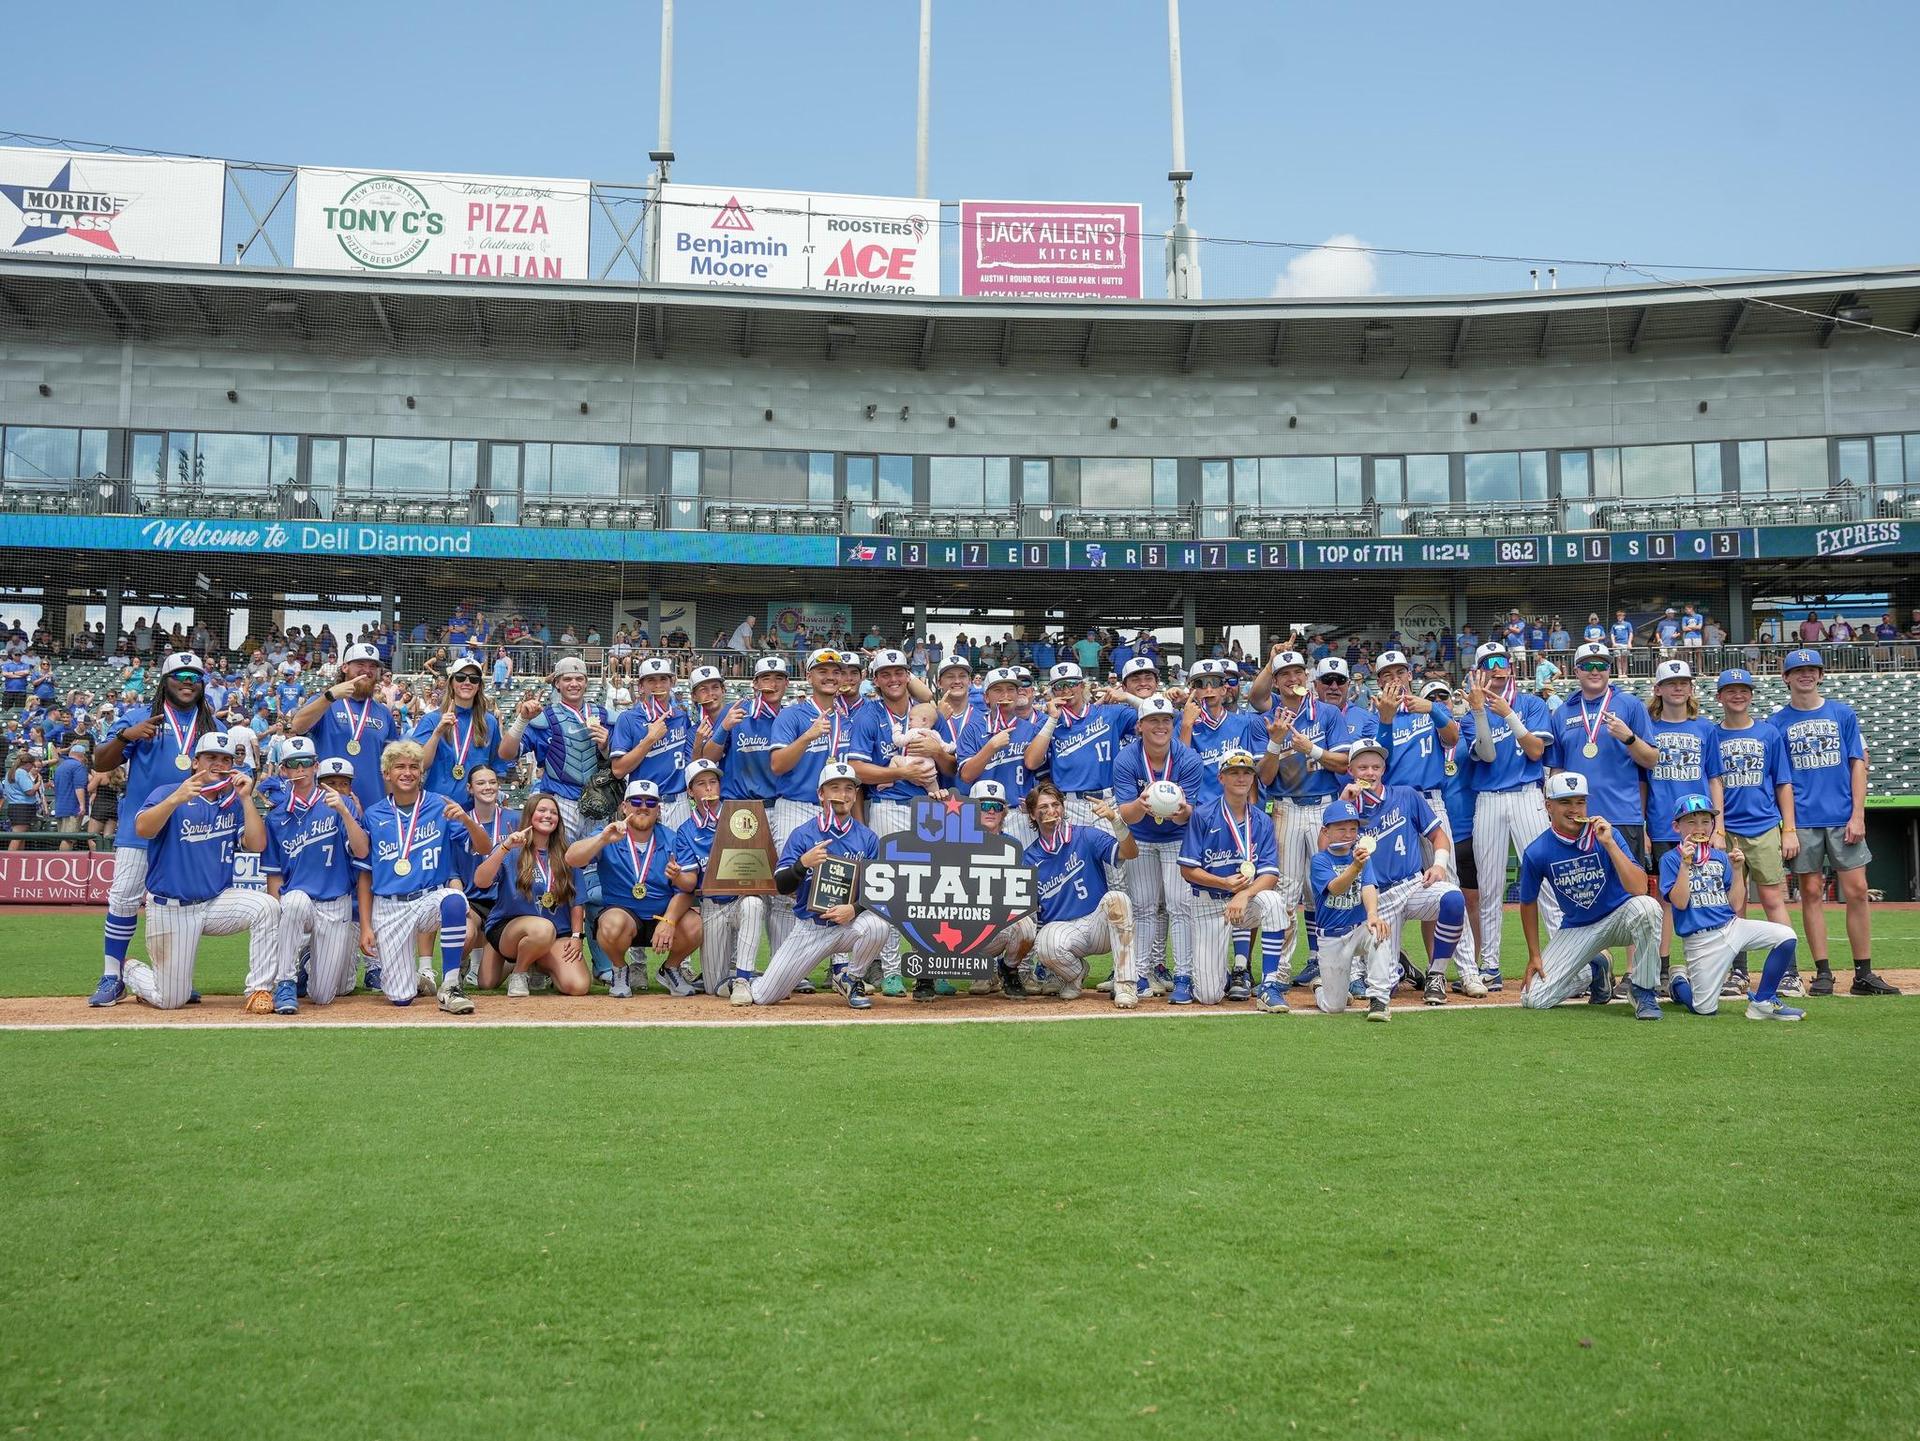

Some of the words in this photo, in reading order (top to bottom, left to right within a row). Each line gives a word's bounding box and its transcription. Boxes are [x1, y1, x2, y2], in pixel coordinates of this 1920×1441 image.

[28, 192, 111, 212] MORRIS
[350, 187, 368, 204] NEW
[370, 182, 395, 191] YORK
[396, 186, 420, 207] STYLE
[22, 211, 112, 231] GLASS
[323, 207, 397, 232] TONY
[402, 210, 443, 234] C'S
[468, 202, 548, 234] PIZZA
[827, 219, 913, 236] ROOSTERS
[986, 222, 1036, 243] JACK
[1038, 223, 1116, 245] ALLEN'S
[370, 255, 392, 264] BEER
[394, 239, 422, 262] GARDEN
[479, 238, 534, 251] Authentic
[676, 232, 788, 259] Benjamin
[802, 245, 816, 254] AT
[823, 238, 917, 280] ACE
[1039, 249, 1114, 261] KITCHEN
[690, 256, 768, 278] Moore
[824, 279, 916, 295] Hardware
[980, 274, 1004, 283] AUSTIN
[1009, 275, 1032, 284] ROUND
[1033, 275, 1050, 284] ROCK
[1056, 275, 1077, 285] CEDAR
[1078, 276, 1096, 285] PARK
[1101, 276, 1123, 286] HUTTO
[142, 520, 260, 549] Welcome
[264, 523, 290, 548] to
[302, 527, 349, 550] Dell
[358, 528, 472, 552] Diamond
[1816, 522, 1901, 556] EXPRESS
[886, 546, 896, 561] R
[910, 545, 919, 562] 3
[945, 547, 956, 562] H
[970, 546, 980, 563] 7
[1008, 547, 1018, 562] E
[1030, 546, 1040, 563] 0
[1126, 549, 1136, 564] R
[1149, 547, 1158, 564] 5
[1184, 549, 1195, 564] H
[1209, 547, 1219, 565] 7
[1247, 549, 1256, 564] E
[1269, 546, 1279, 564] 2
[1317, 546, 1349, 563] TOP
[1353, 546, 1370, 563] of
[1374, 545, 1404, 562] 7TH
[1422, 543, 1470, 560] 11:24
[1501, 542, 1534, 560] 86.2
[1567, 542, 1577, 558] B
[1592, 539, 1601, 557] 0
[1629, 541, 1639, 555] S
[1655, 538, 1665, 555] 0
[1720, 535, 1730, 552] 3
[1400, 617, 1427, 627] TONY
[1411, 713, 1434, 731] Hill
[1788, 721, 1839, 740] STATE
[669, 726, 687, 742] Hill
[737, 732, 769, 748] Spring
[1055, 733, 1084, 754] Spring
[1085, 716, 1107, 736] Hill
[1655, 734, 1701, 752] STATE
[1094, 740, 1112, 762] 17
[1790, 740, 1804, 755] 20
[1826, 737, 1840, 750] 25
[1688, 752, 1701, 765] 25
[1751, 757, 1765, 770] 25
[1792, 751, 1841, 770] BOUND
[1016, 765, 1025, 785] 8
[1653, 765, 1701, 781] BOUND
[181, 818, 214, 839] Spring
[215, 813, 238, 831] Hill
[917, 801, 984, 844] UIL
[1380, 807, 1404, 831] Hill
[282, 830, 309, 854] Spring
[311, 816, 335, 836] Hill
[414, 820, 436, 842] Hill
[1394, 834, 1406, 856] 4
[322, 844, 334, 867] 7
[20, 858, 117, 888] LIQUO
[1553, 867, 1605, 886] CHAMPIONS
[13, 887, 43, 899] FINE
[48, 888, 86, 900] WINE
[820, 882, 848, 897] MVP
[864, 863, 1032, 906] STATE
[1037, 872, 1065, 896] Spring
[1073, 878, 1089, 900] 5
[1691, 891, 1730, 908] BOUN
[907, 905, 991, 921] CHAMPIONS
[928, 956, 988, 971] SOUTHERN
